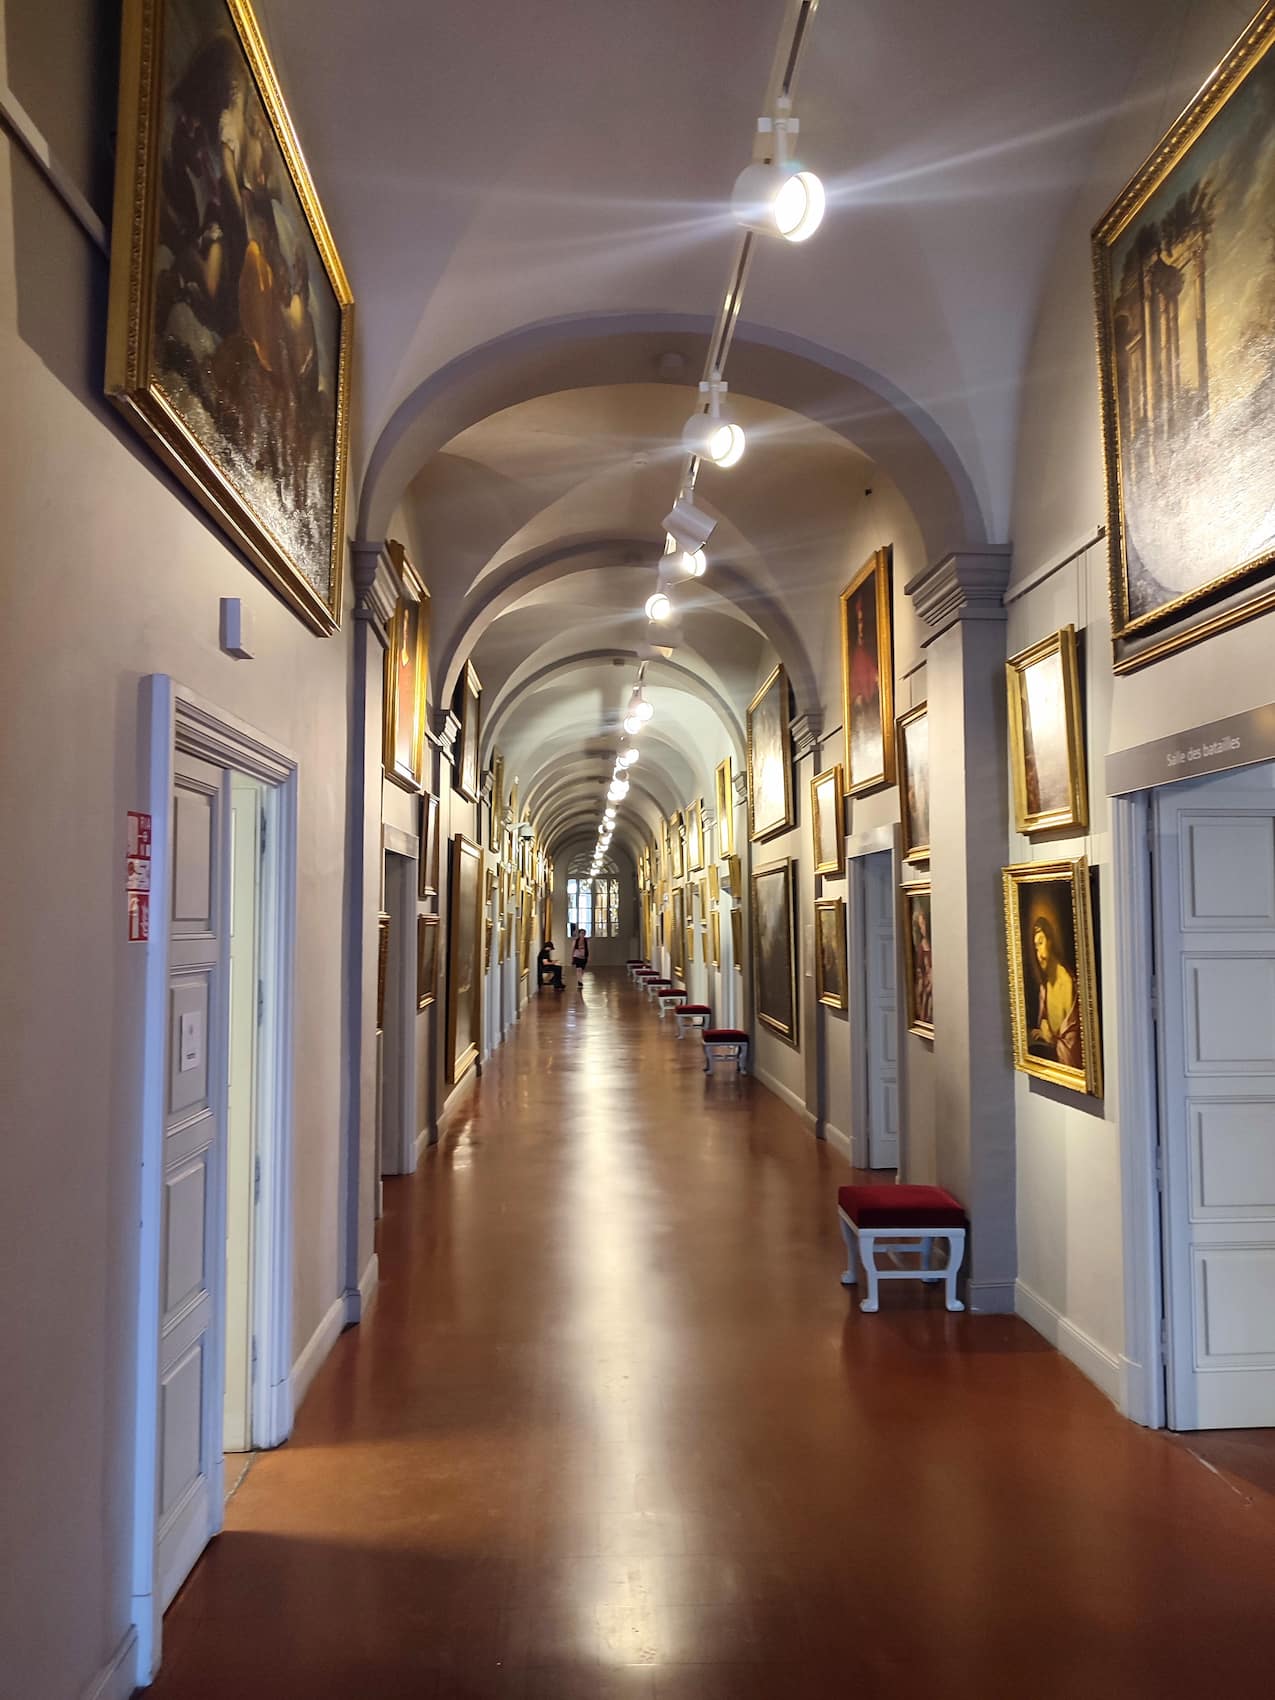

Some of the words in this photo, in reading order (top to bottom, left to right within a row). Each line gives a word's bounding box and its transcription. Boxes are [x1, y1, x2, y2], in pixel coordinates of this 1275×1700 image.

[1166, 751, 1186, 767] Salle
[1187, 747, 1201, 761] des
[1203, 736, 1241, 757] batailles
